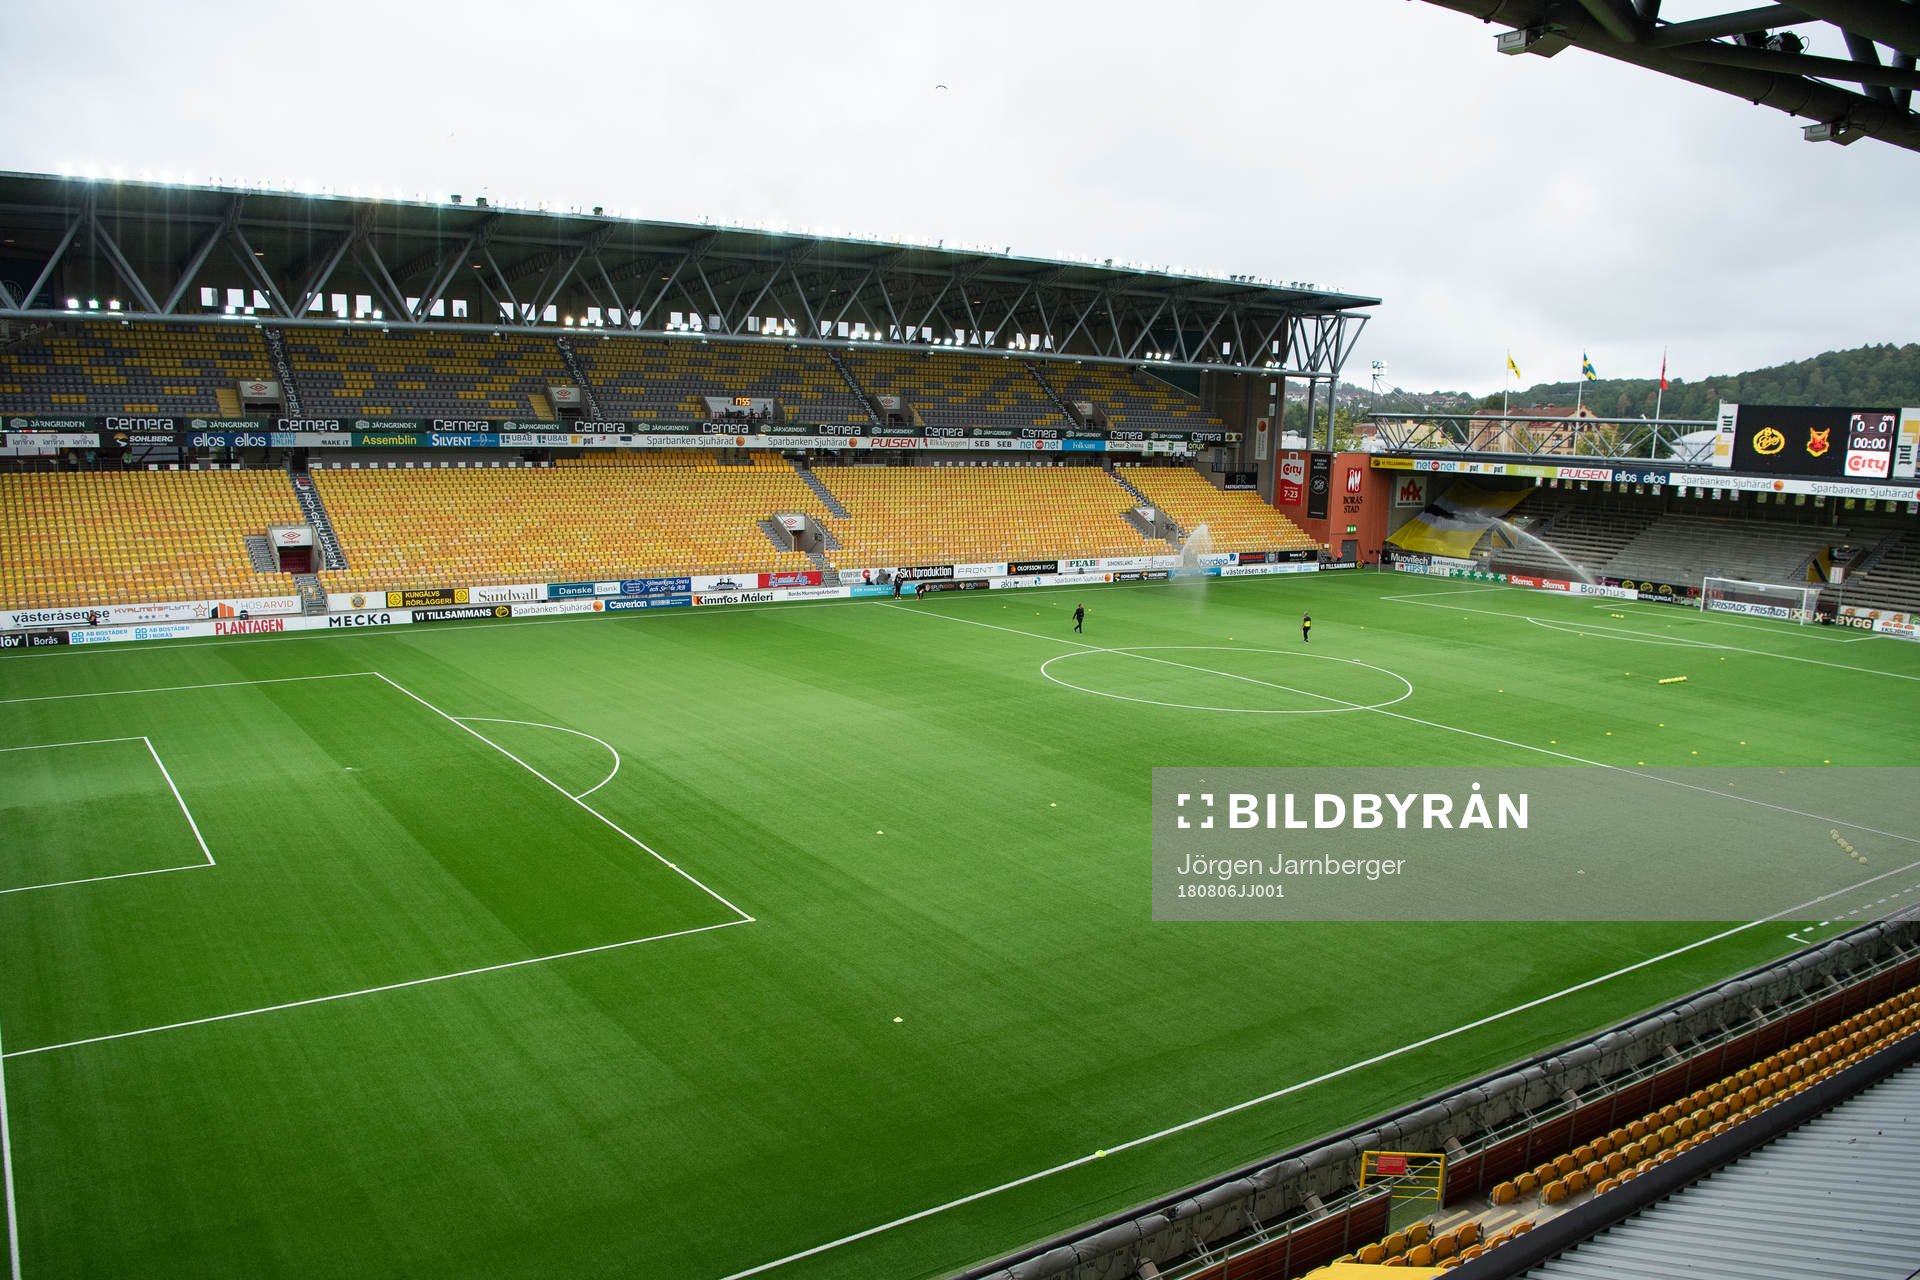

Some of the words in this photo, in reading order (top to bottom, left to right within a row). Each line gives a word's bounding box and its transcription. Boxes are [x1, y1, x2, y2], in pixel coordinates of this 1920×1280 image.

[30, 420, 85, 428] JÄRNGRINDEN
[106, 417, 173, 430] Cernera
[209, 420, 259, 428] JÄRNGRINDEN
[278, 419, 339, 431] Cernera
[433, 420, 489, 431] Cernera
[575, 421, 625, 433] Cernera
[703, 422, 748, 434] Cernera
[819, 424, 861, 435] Cernera
[1857, 421, 1865, 432] 0
[1879, 421, 1887, 433] 0
[925, 427, 963, 437] Cernera
[1022, 428, 1057, 438] Cernera
[1111, 430, 1143, 440] Cernera
[129, 435, 174, 443] SOHLBERG
[193, 433, 225, 447] ellos
[235, 433, 266, 447] ellos
[362, 435, 417, 445] Assemblin
[431, 434, 472, 446] SILVENT
[647, 436, 696, 446] Sparbanken
[698, 436, 734, 446] Sjuhärad
[768, 437, 813, 447] Sparbanken
[815, 438, 847, 447] Sjuhärad
[870, 438, 917, 448] PULSEN
[997, 440, 1012, 448] SEB
[1853, 437, 1886, 450] 00:00
[1283, 463, 1302, 476] City
[1848, 455, 1887, 472] City
[1559, 468, 1609, 480] PULSEN
[1615, 470, 1637, 483] ellos
[1643, 472, 1666, 485] ellos
[1681, 475, 1730, 488] Sparbanken
[1733, 477, 1772, 490] Sjuhärad
[1400, 478, 1422, 501] MAX
[1811, 483, 1867, 496] Sparbanken
[1870, 486, 1914, 499] Sjuhärad
[1343, 495, 1363, 505] BORÅS
[1344, 505, 1359, 513] STAD
[1069, 559, 1096, 568] PEAB
[1390, 552, 1428, 566] MuoviTech
[957, 566, 994, 575] FRONT
[405, 590, 440, 598] KUNGÄLVS
[478, 588, 538, 602] Sandwall
[559, 586, 592, 595] Danske
[597, 585, 618, 593] Bank
[405, 598, 452, 607] RÖRLÄGGERI
[741, 592, 773, 602] Måleri
[514, 604, 558, 615] Sparbanken
[560, 603, 591, 613] Sjuhärad
[609, 599, 647, 610] Caverion
[1711, 600, 1747, 612] FRISTADS
[12, 608, 110, 624] västeråsense
[415, 612, 424, 621] VI
[427, 608, 492, 620] TILLSAMMANS
[1750, 605, 1787, 617] FRISTADS
[329, 613, 390, 628] MECKA
[1814, 612, 1873, 630] X-BYGG
[159, 625, 190, 633] BOSTÄDER
[215, 618, 284, 636] PLANTAGEN
[34, 636, 58, 646] Borås
[152, 631, 173, 639] BORÅS
